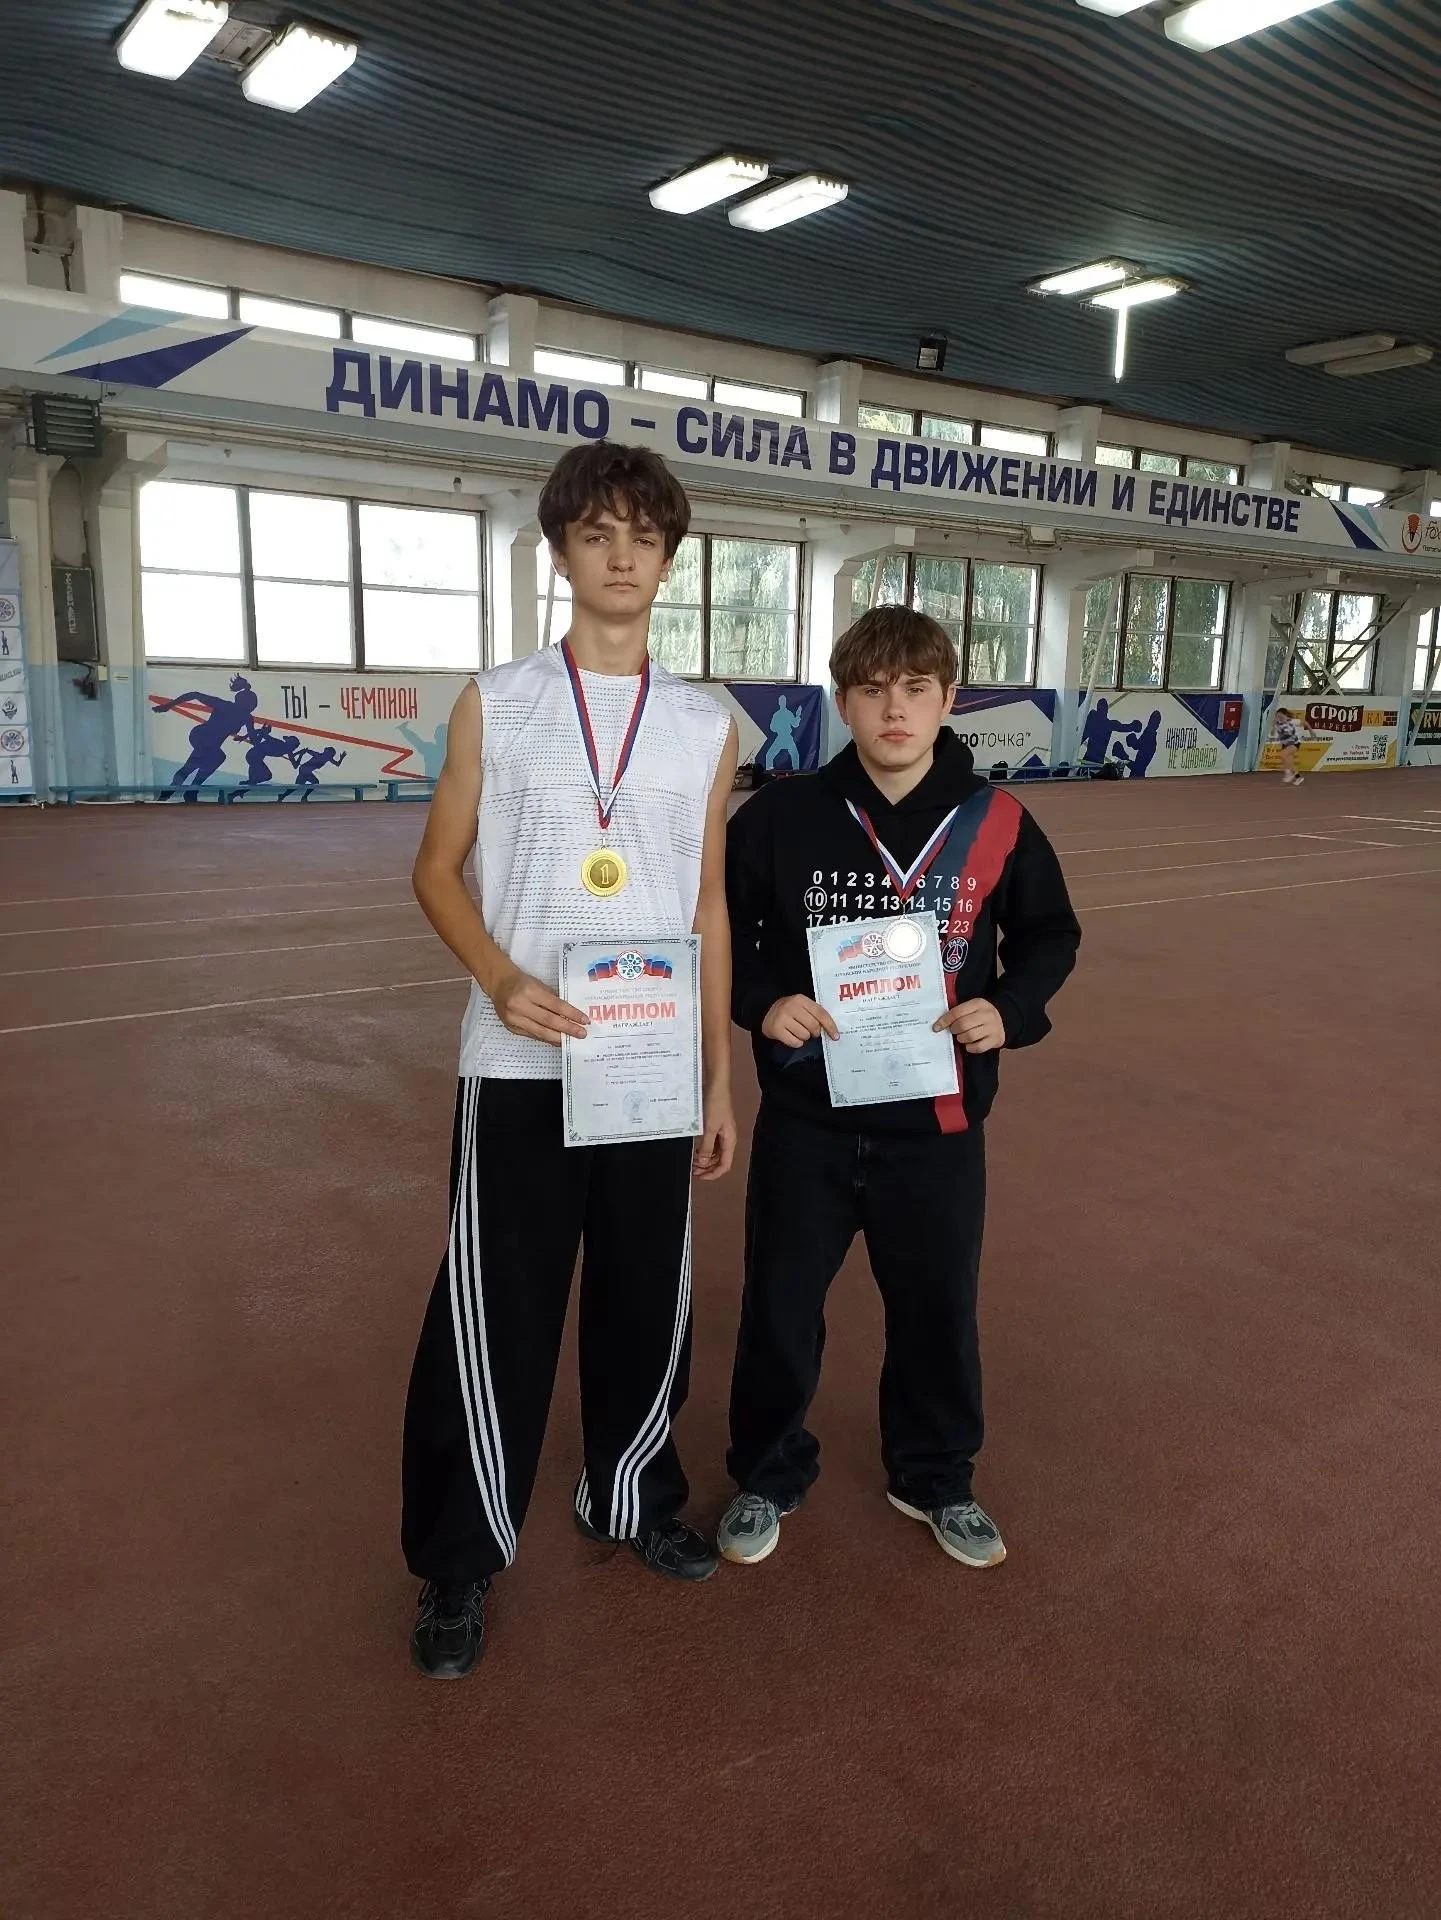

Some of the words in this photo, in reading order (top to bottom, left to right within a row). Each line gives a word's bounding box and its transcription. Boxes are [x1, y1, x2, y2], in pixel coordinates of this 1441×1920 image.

[325, 347, 610, 439] ДИНАМО
[676, 406, 812, 470] СИЛА
[829, 431, 856, 475] В
[870, 438, 1098, 508] ДВИЖЕНИИ
[1111, 474, 1136, 512] И
[1149, 479, 1301, 533] ЕДИНСТВЕ
[281, 685, 308, 719] ТЫ
[340, 686, 418, 719] ЧЕМПИОН
[1310, 705, 1359, 722] СТРОЙ
[1313, 721, 1353, 732] МАРКЕТ
[1165, 727, 1198, 749] НИКОГДА
[1180, 744, 1218, 769] СДАВАЙСЯ
[600, 863, 609, 885] 1
[812, 870, 823, 885] 0
[830, 871, 839, 885] 1
[846, 871, 858, 886] 2
[864, 872, 875, 887] 3
[881, 873, 892, 888] 4
[915, 874, 926, 889] 6
[934, 875, 943, 888] 7
[950, 876, 960, 889] 8
[967, 877, 977, 891] 9
[806, 892, 825, 907] 10
[830, 892, 848, 908] 11
[855, 894, 875, 909] 12
[880, 895, 900, 910] 13
[906, 895, 926, 910] 14
[933, 897, 952, 911] 15
[957, 899, 973, 913] 16
[806, 913, 824, 928] 17
[952, 920, 970, 934] 23
[839, 975, 920, 1002] ДИПЛОМ
[587, 1001, 676, 1023] ДИПЛОМ
